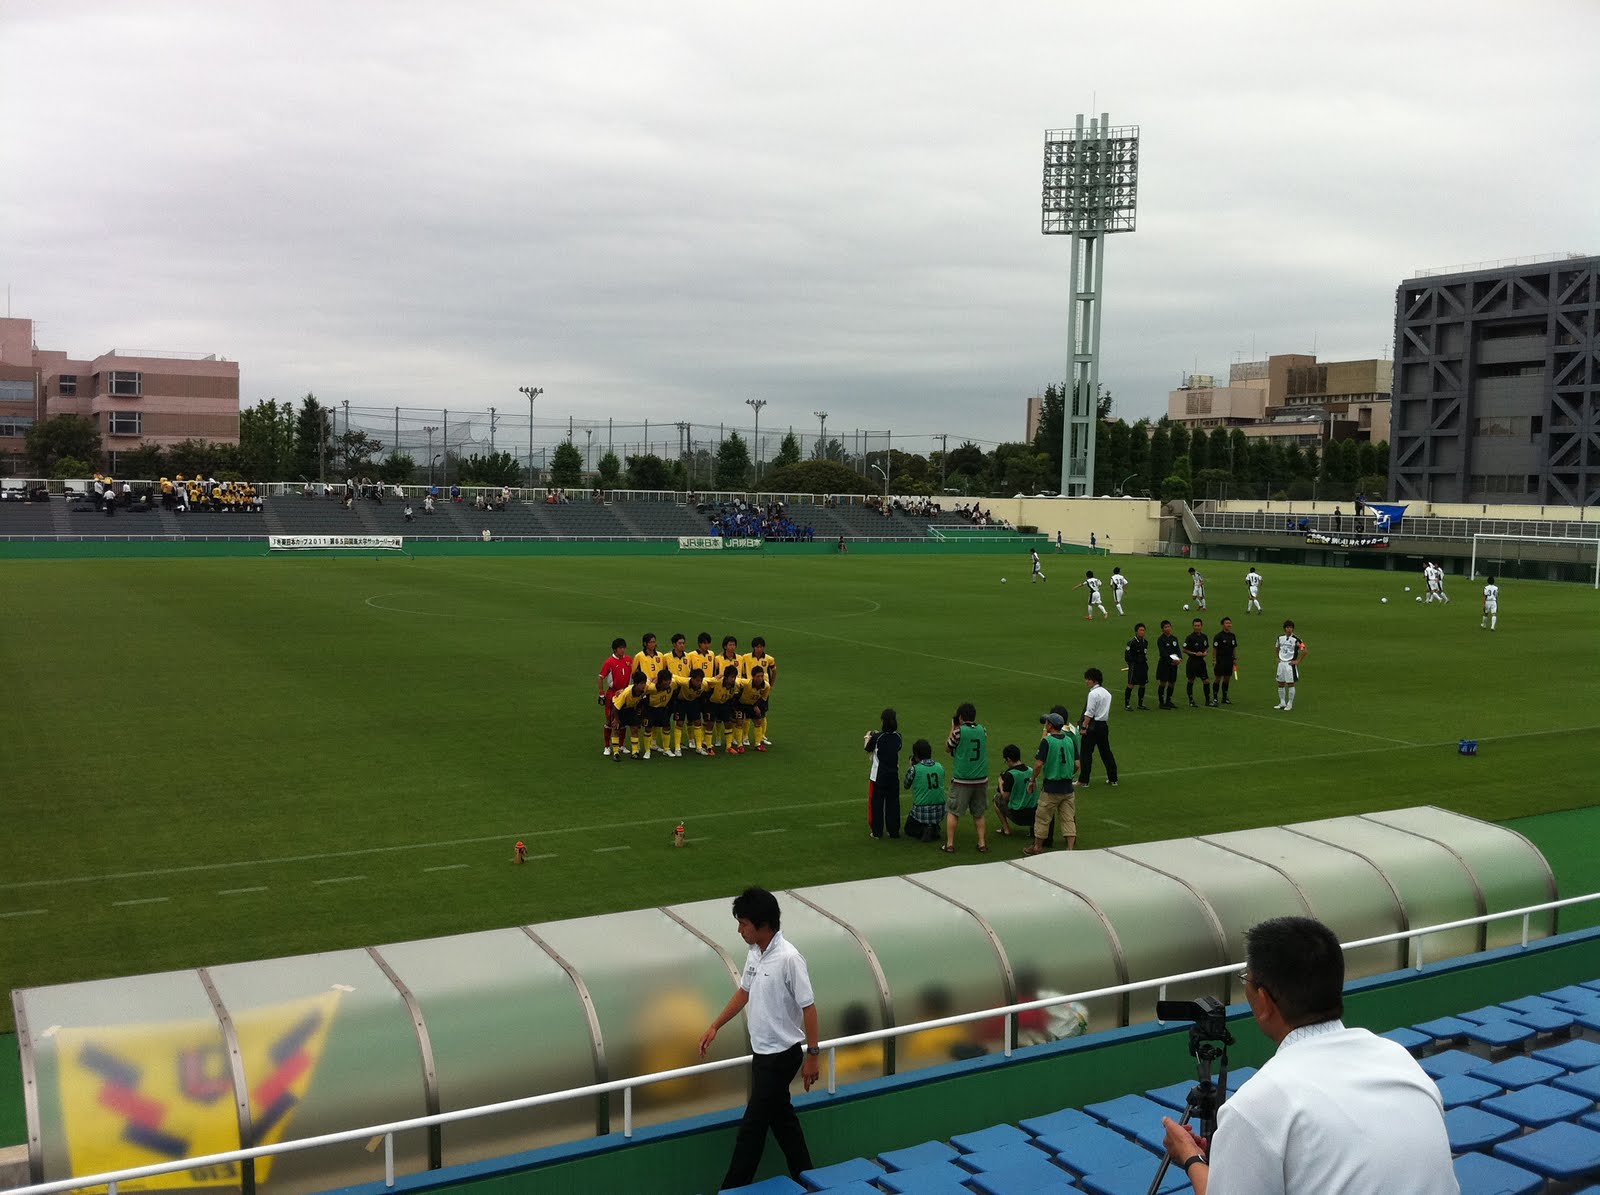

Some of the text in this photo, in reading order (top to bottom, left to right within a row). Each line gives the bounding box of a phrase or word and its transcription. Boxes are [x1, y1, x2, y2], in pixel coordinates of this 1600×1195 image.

[622, 667, 625, 676] 1
[650, 663, 656, 672] 3
[701, 662, 708, 670] 15
[969, 739, 980, 762] 3
[1060, 746, 1067, 764] 1
[926, 772, 939, 790] 13
